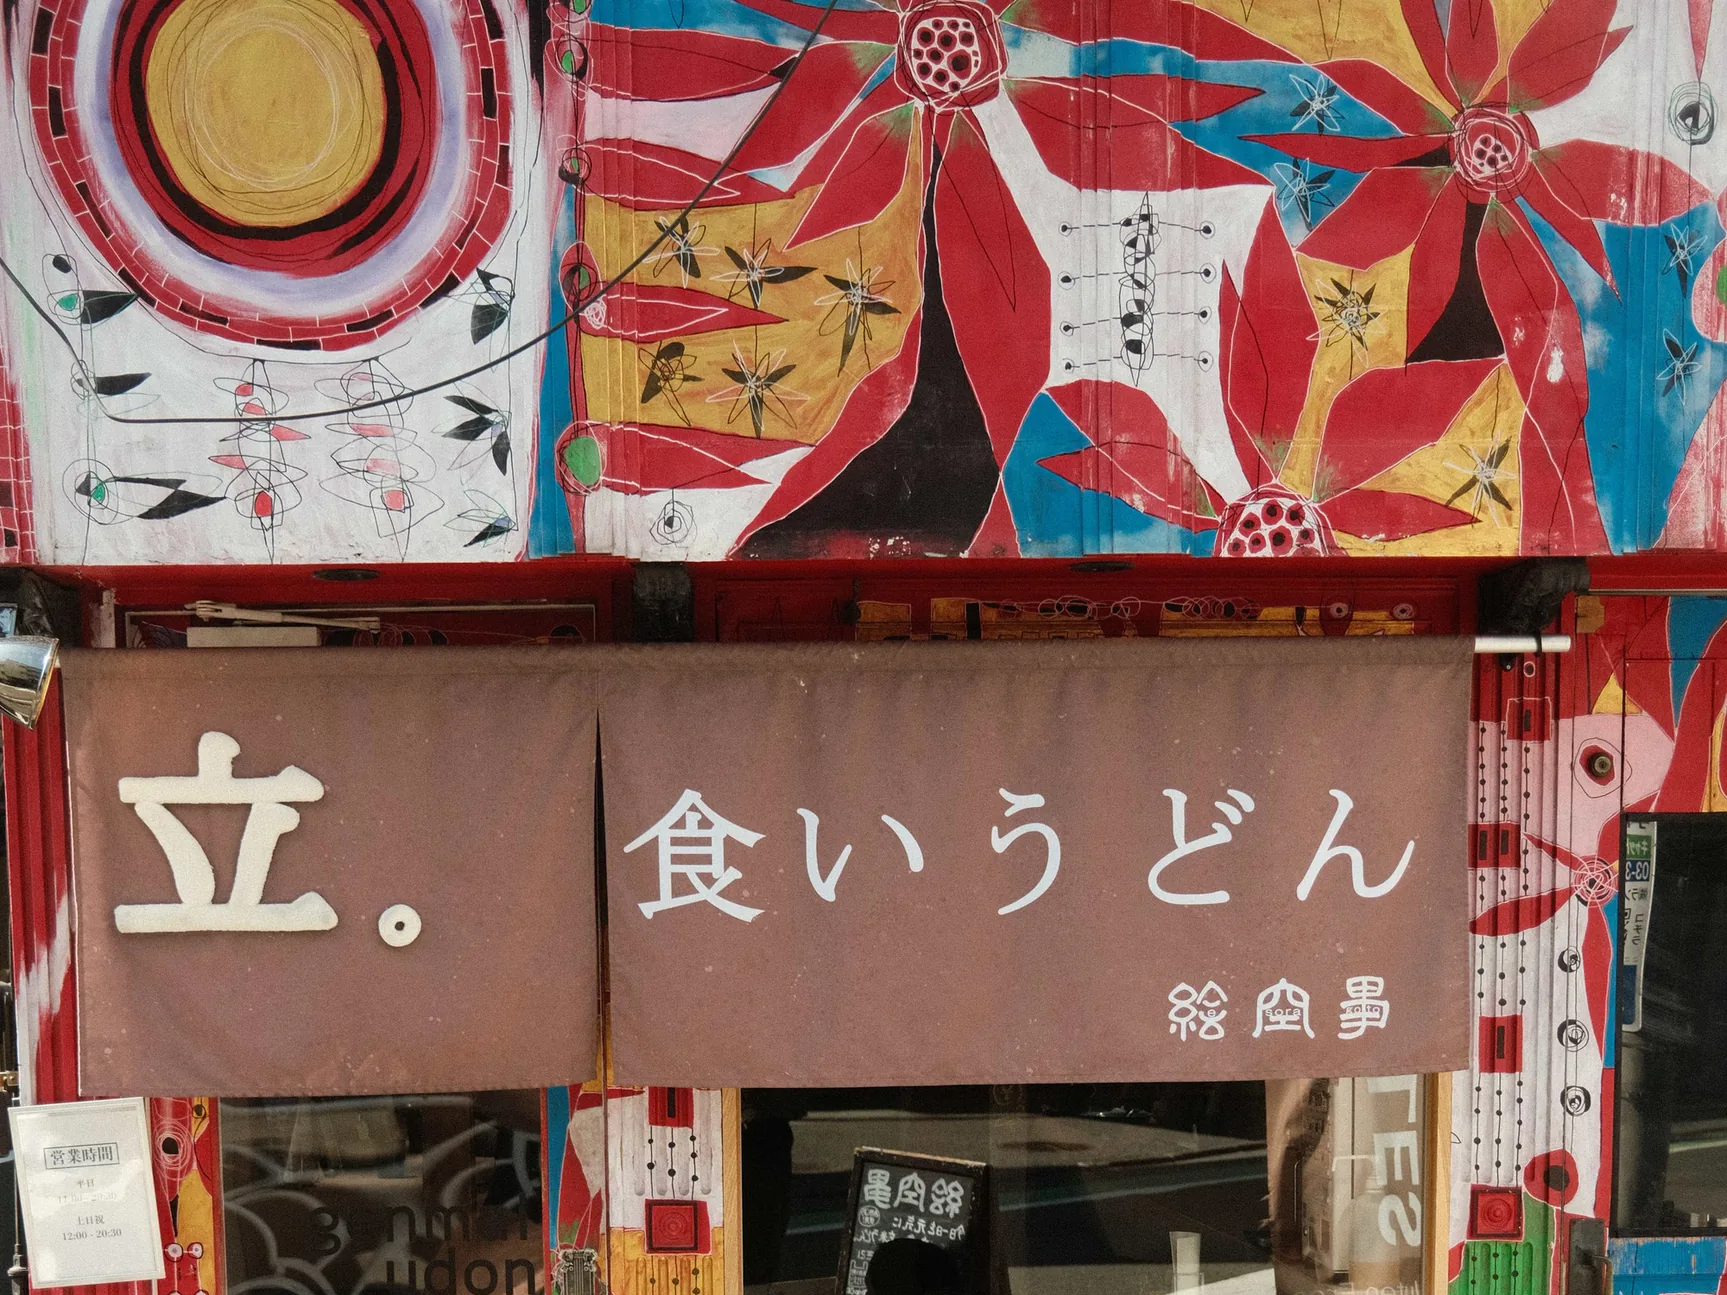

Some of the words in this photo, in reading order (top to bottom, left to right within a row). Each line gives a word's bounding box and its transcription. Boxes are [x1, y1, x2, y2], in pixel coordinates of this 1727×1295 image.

[623, 788, 1416, 924] 食いうどん
[50, 1146, 114, 1167] 営業時間
[62, 1231, 87, 1241] 12:00
[96, 1228, 122, 1239] 20:30
